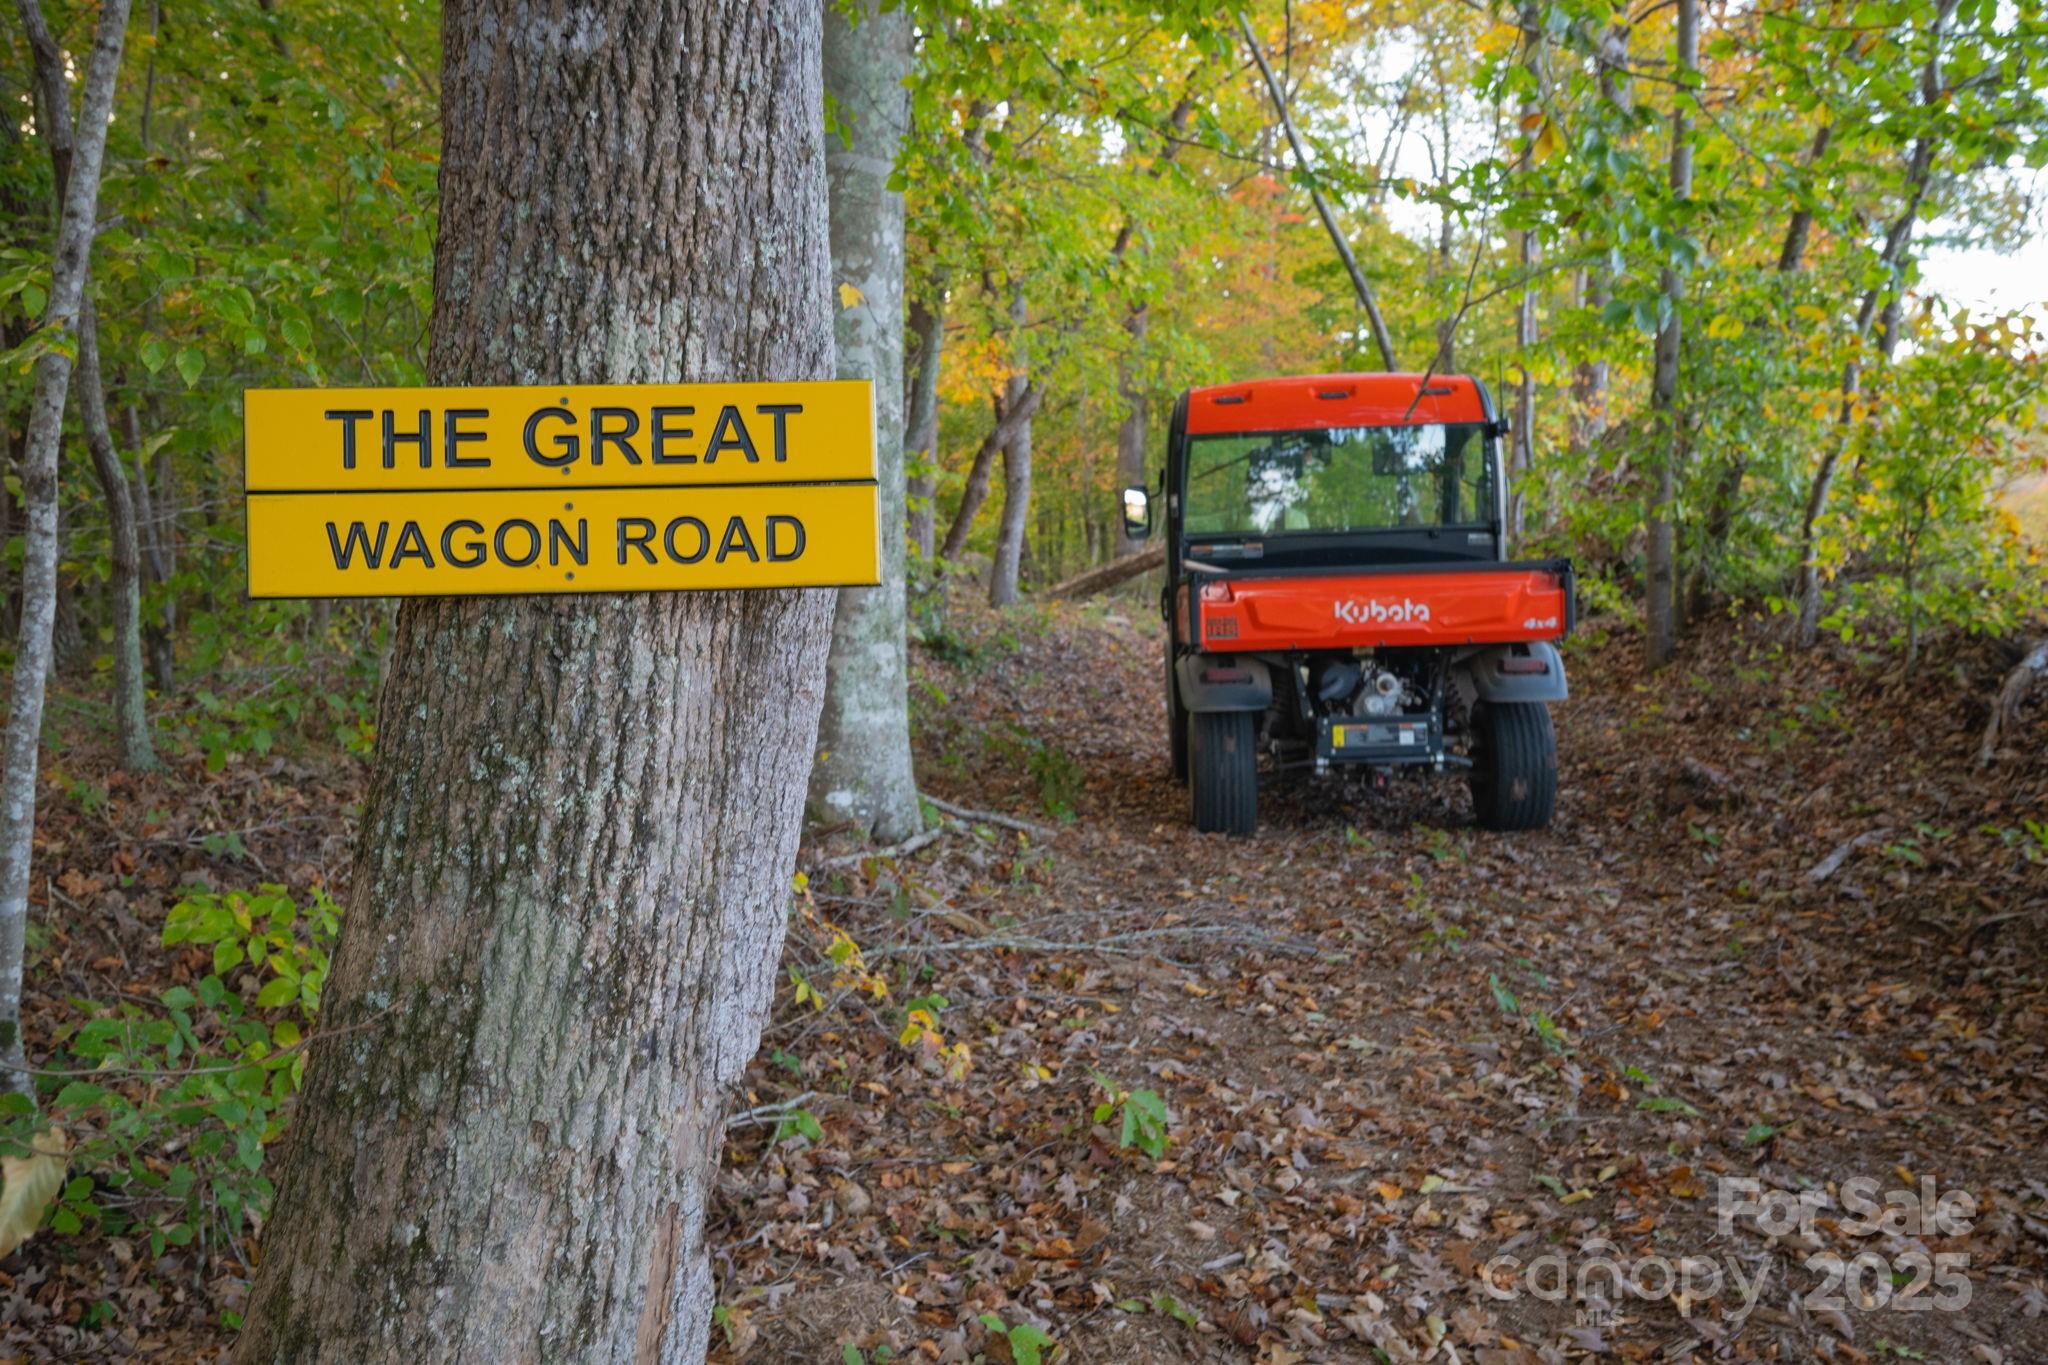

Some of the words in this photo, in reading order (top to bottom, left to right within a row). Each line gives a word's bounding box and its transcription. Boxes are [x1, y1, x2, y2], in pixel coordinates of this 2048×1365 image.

[325, 408, 491, 469] THE
[523, 405, 803, 467] GREAT
[326, 517, 589, 569] WAGON
[617, 515, 806, 565] ROAD
[1334, 598, 1430, 623] Kubota
